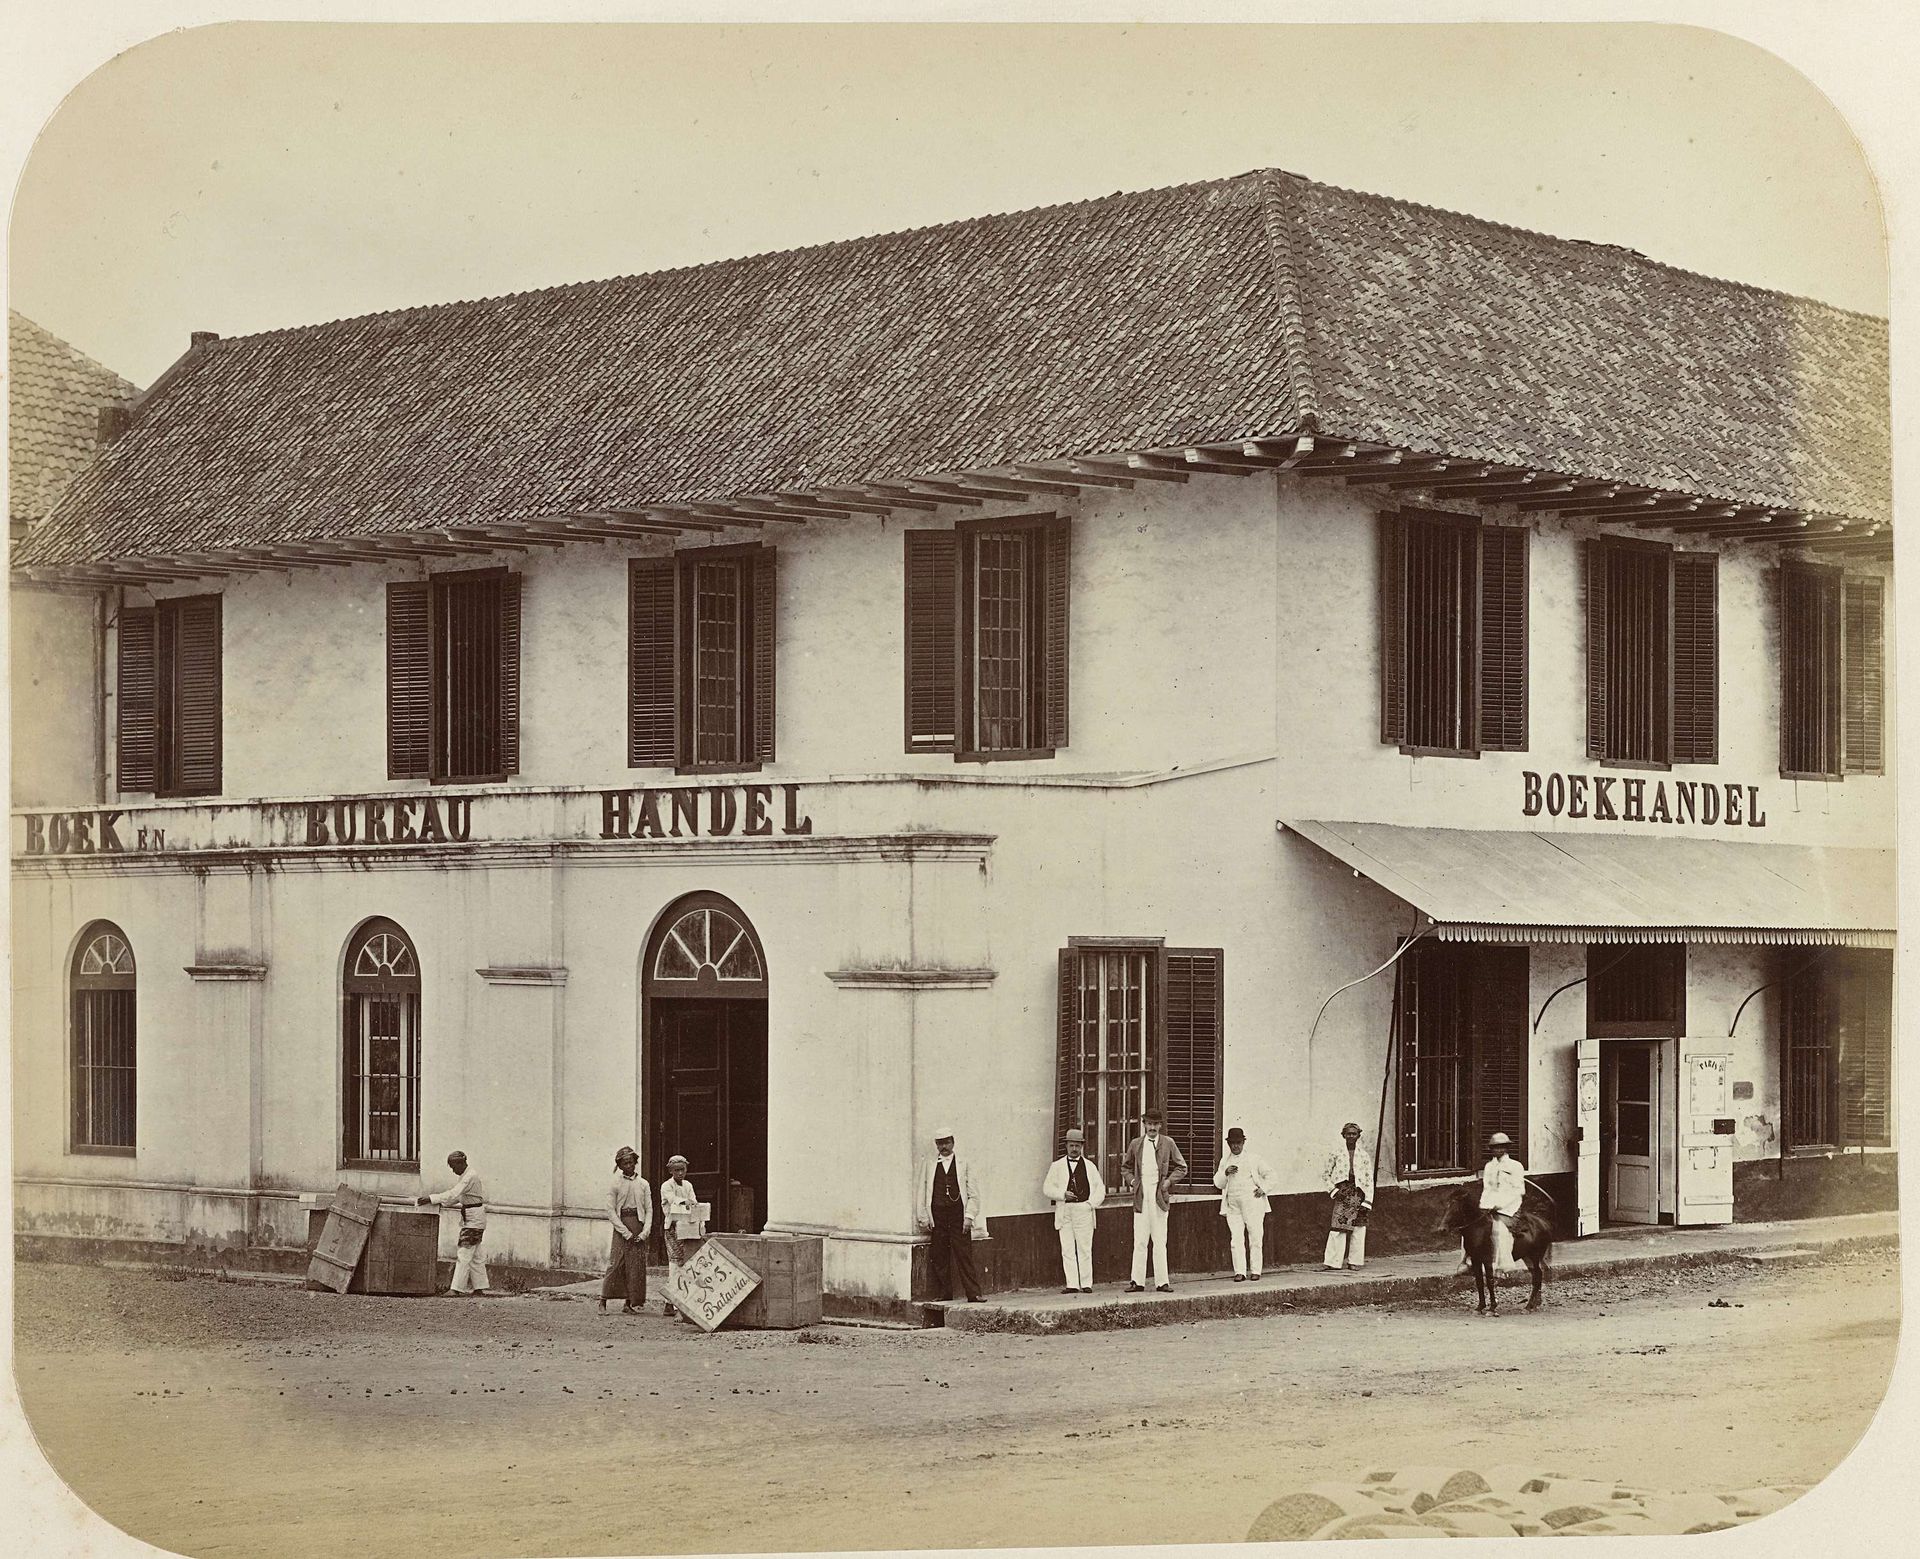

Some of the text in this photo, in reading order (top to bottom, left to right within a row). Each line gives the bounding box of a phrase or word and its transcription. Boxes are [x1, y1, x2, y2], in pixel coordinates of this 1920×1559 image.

[24, 784, 812, 855] BOEK EN BUREAU HANDEL
[1522, 771, 1766, 827] BOEKHANDEL
[703, 1278, 747, 1320] Batavia
